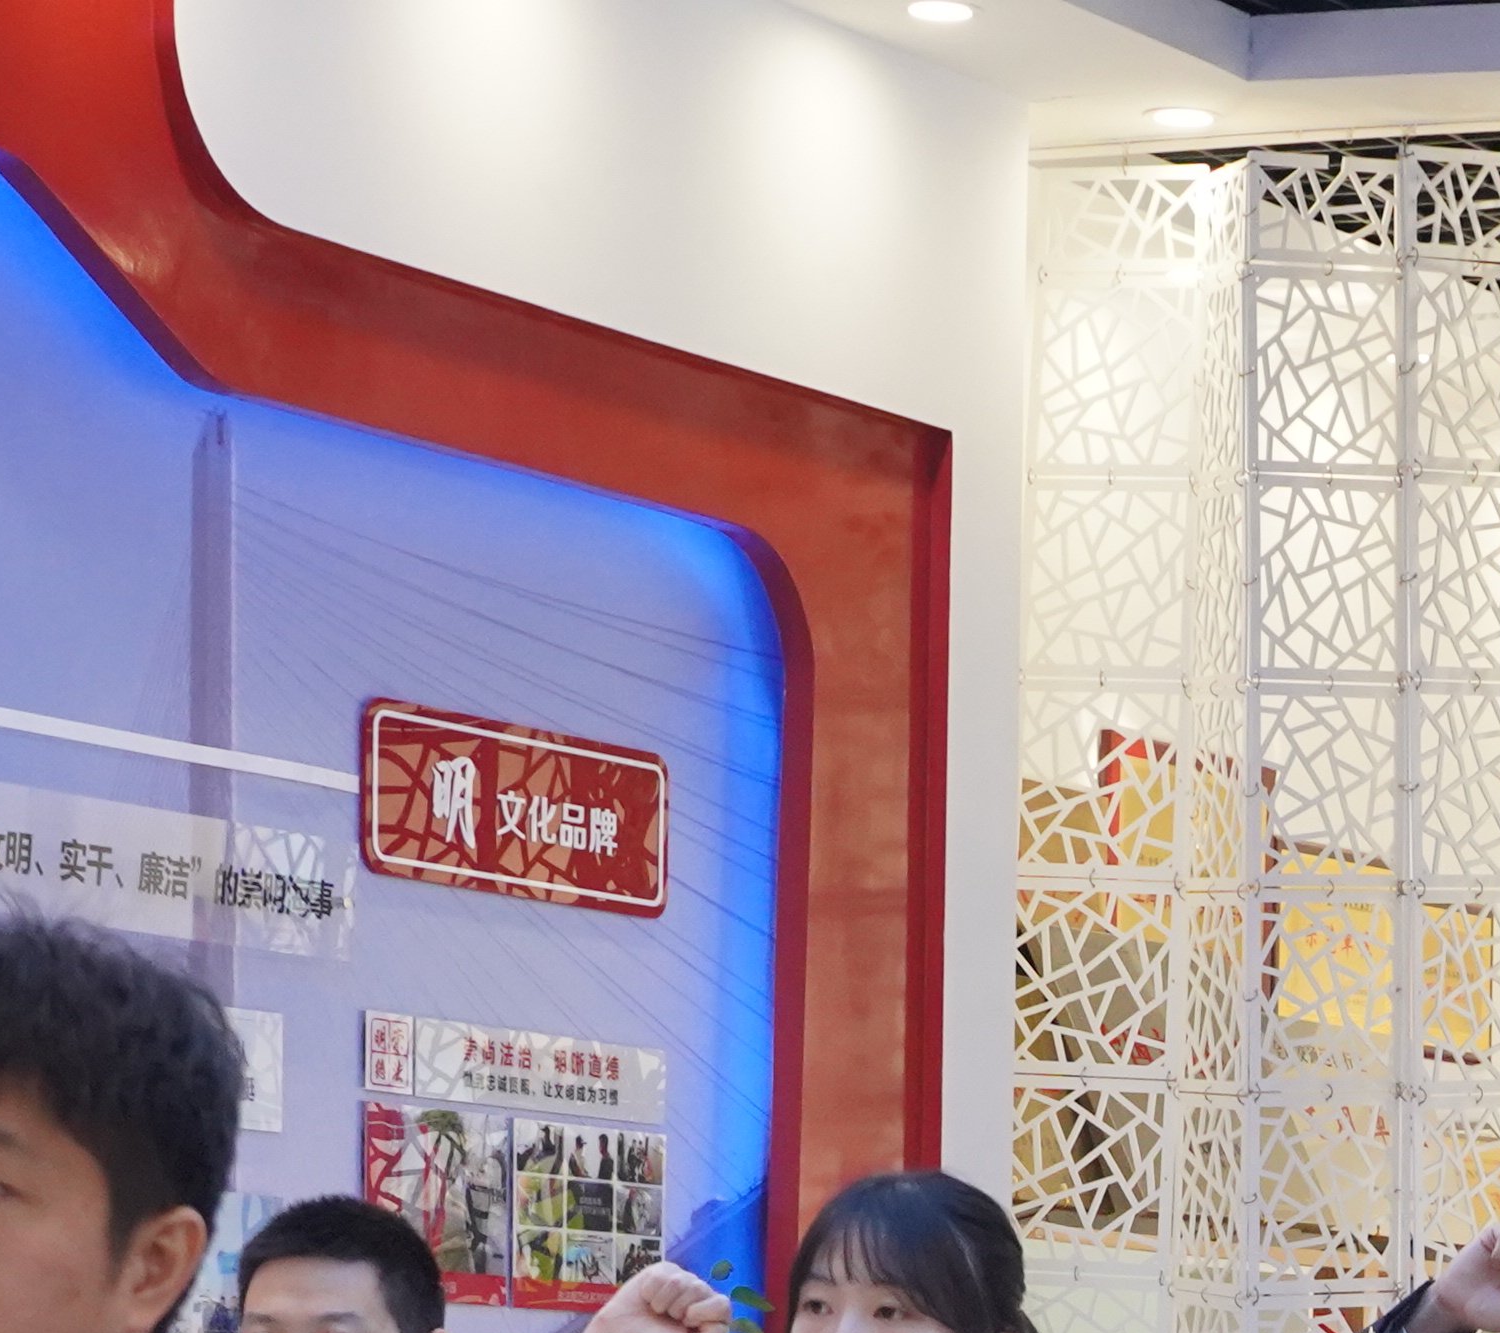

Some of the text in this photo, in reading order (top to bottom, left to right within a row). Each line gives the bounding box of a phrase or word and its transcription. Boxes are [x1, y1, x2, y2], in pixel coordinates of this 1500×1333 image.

[431, 755, 619, 858] 明 文化品牌
